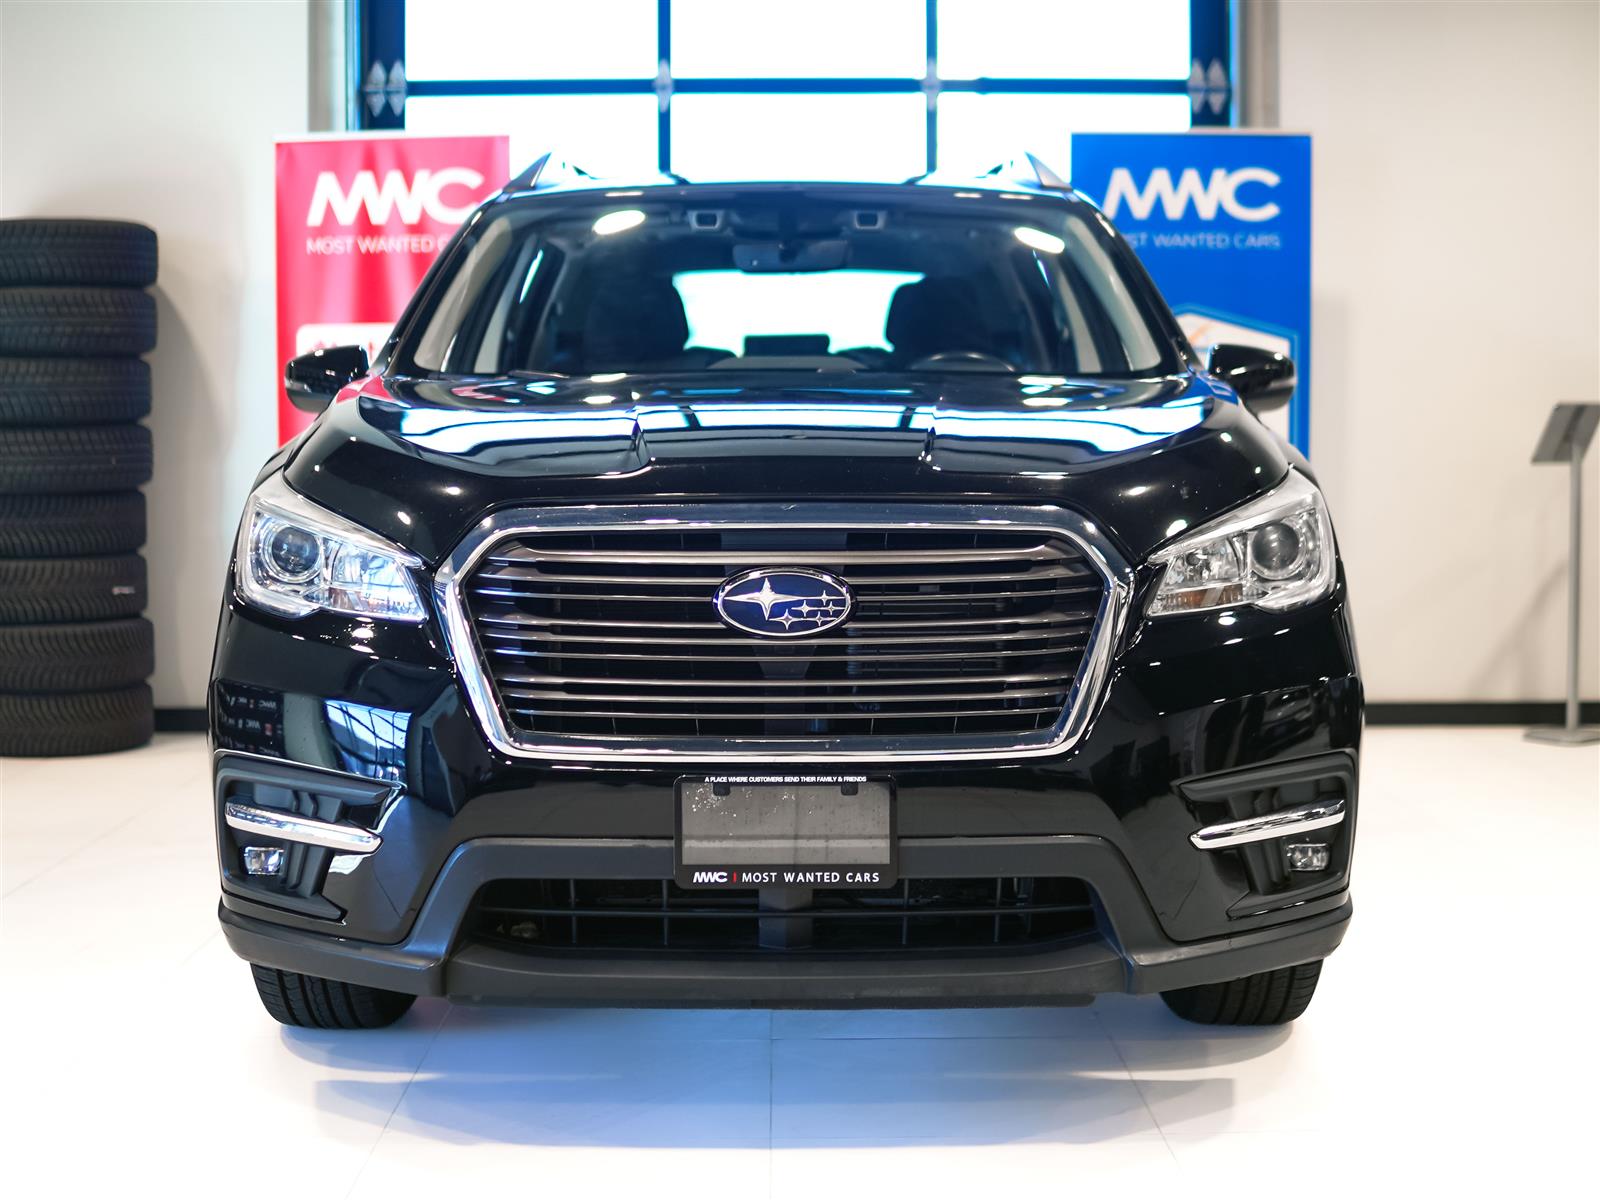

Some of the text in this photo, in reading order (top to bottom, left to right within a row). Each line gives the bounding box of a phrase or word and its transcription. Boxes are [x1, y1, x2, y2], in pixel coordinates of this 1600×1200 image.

[307, 167, 485, 226] MWC
[1101, 167, 1281, 222] MWC
[306, 235, 352, 255] MOST
[357, 234, 433, 254] WANTED
[1152, 232, 1230, 249] WANTED
[1233, 232, 1281, 249] CARS
[692, 871, 880, 883] MWC MOST WANTED CARS
